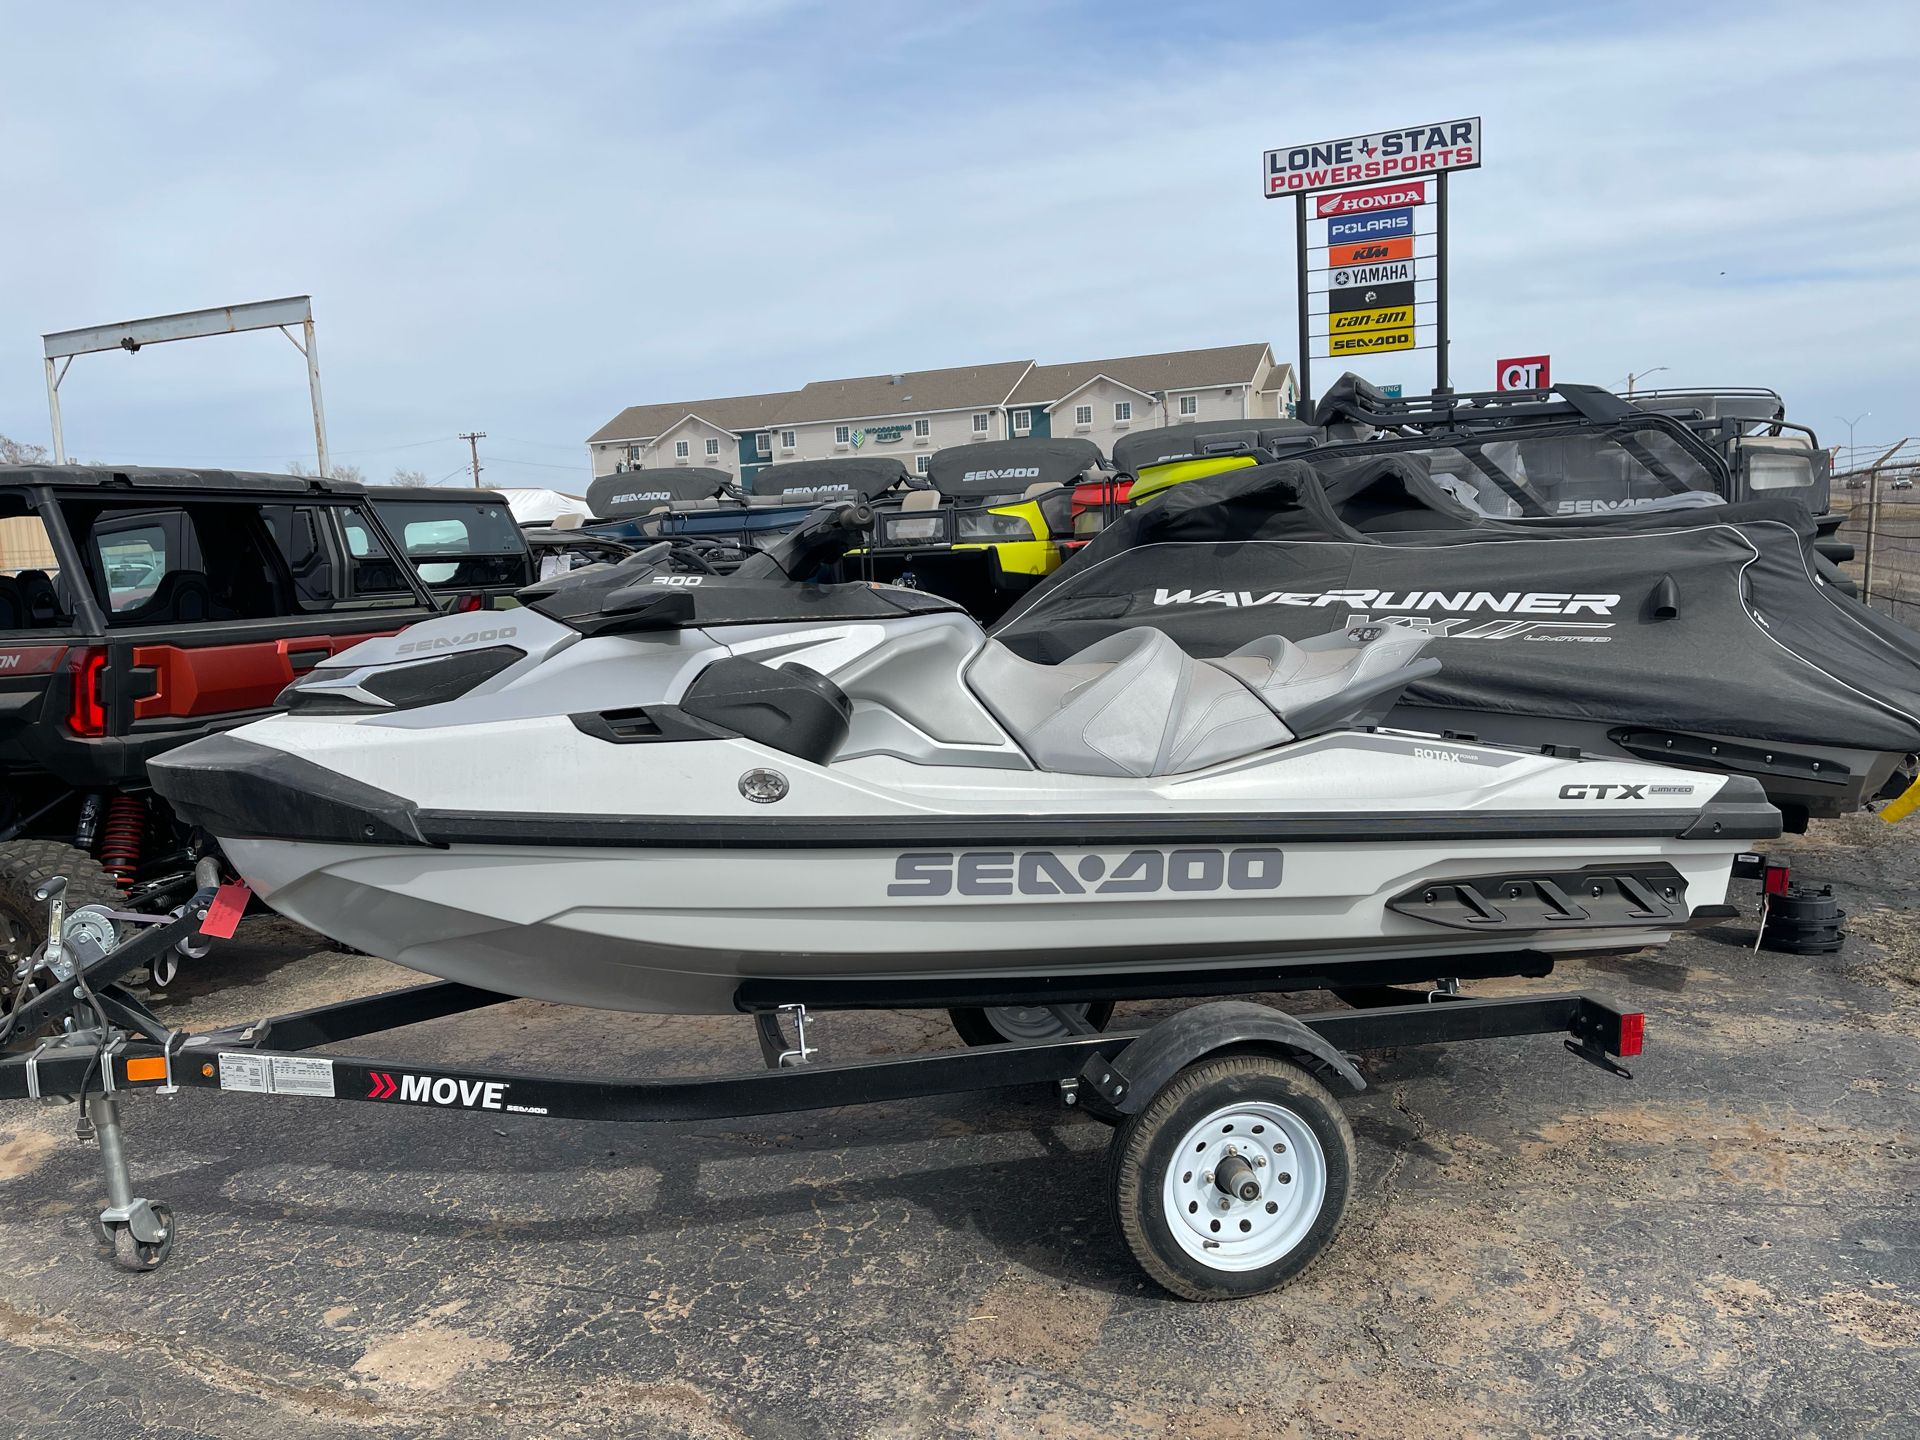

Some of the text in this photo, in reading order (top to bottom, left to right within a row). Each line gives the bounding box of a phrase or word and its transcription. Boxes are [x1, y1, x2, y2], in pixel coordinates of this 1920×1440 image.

[1271, 122, 1472, 174] LONE STAR
[1271, 147, 1473, 192] POWERSPORTS
[1343, 190, 1421, 211] HONDA
[1332, 217, 1409, 236] POLARIS
[1353, 246, 1388, 260] KTM
[1352, 264, 1408, 284] YAMAHA
[1501, 363, 1541, 391] QT
[1153, 588, 1622, 615] WAVERUNNER
[1414, 747, 1461, 763] ROTAX
[1559, 784, 1693, 799] GTX LIMITED
[400, 1075, 505, 1110] MOVE
